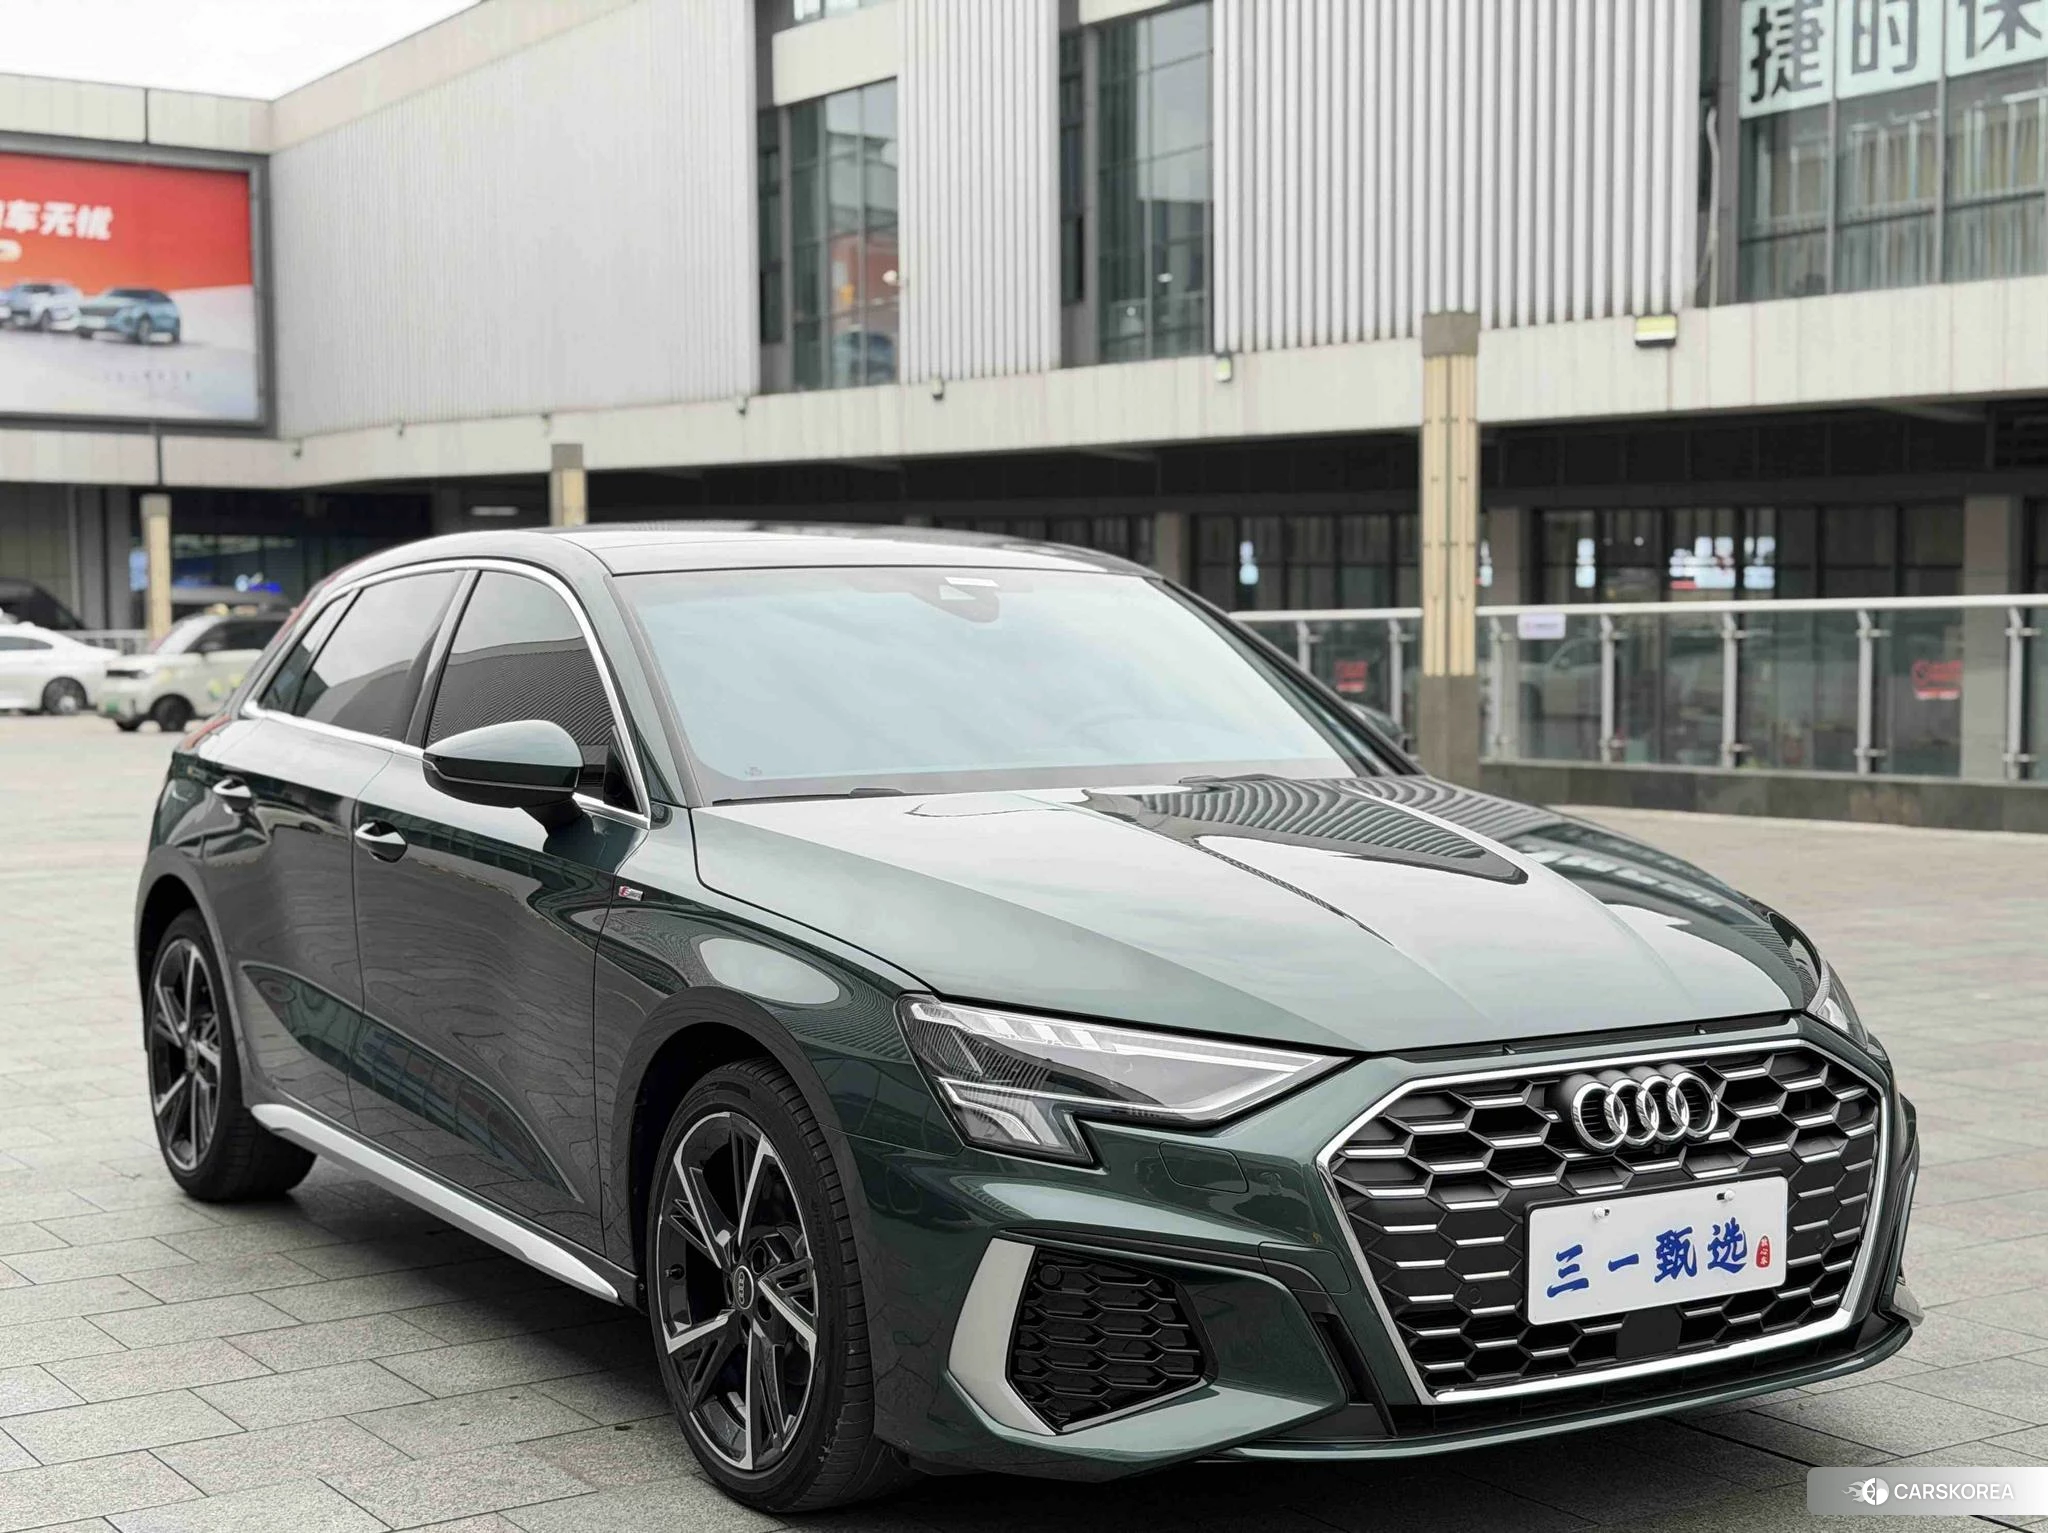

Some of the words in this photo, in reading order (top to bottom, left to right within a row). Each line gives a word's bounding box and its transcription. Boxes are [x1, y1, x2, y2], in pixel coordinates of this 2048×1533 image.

[0, 199, 113, 240] 车无忧
[1547, 1217, 1747, 1297] 三一甄选
